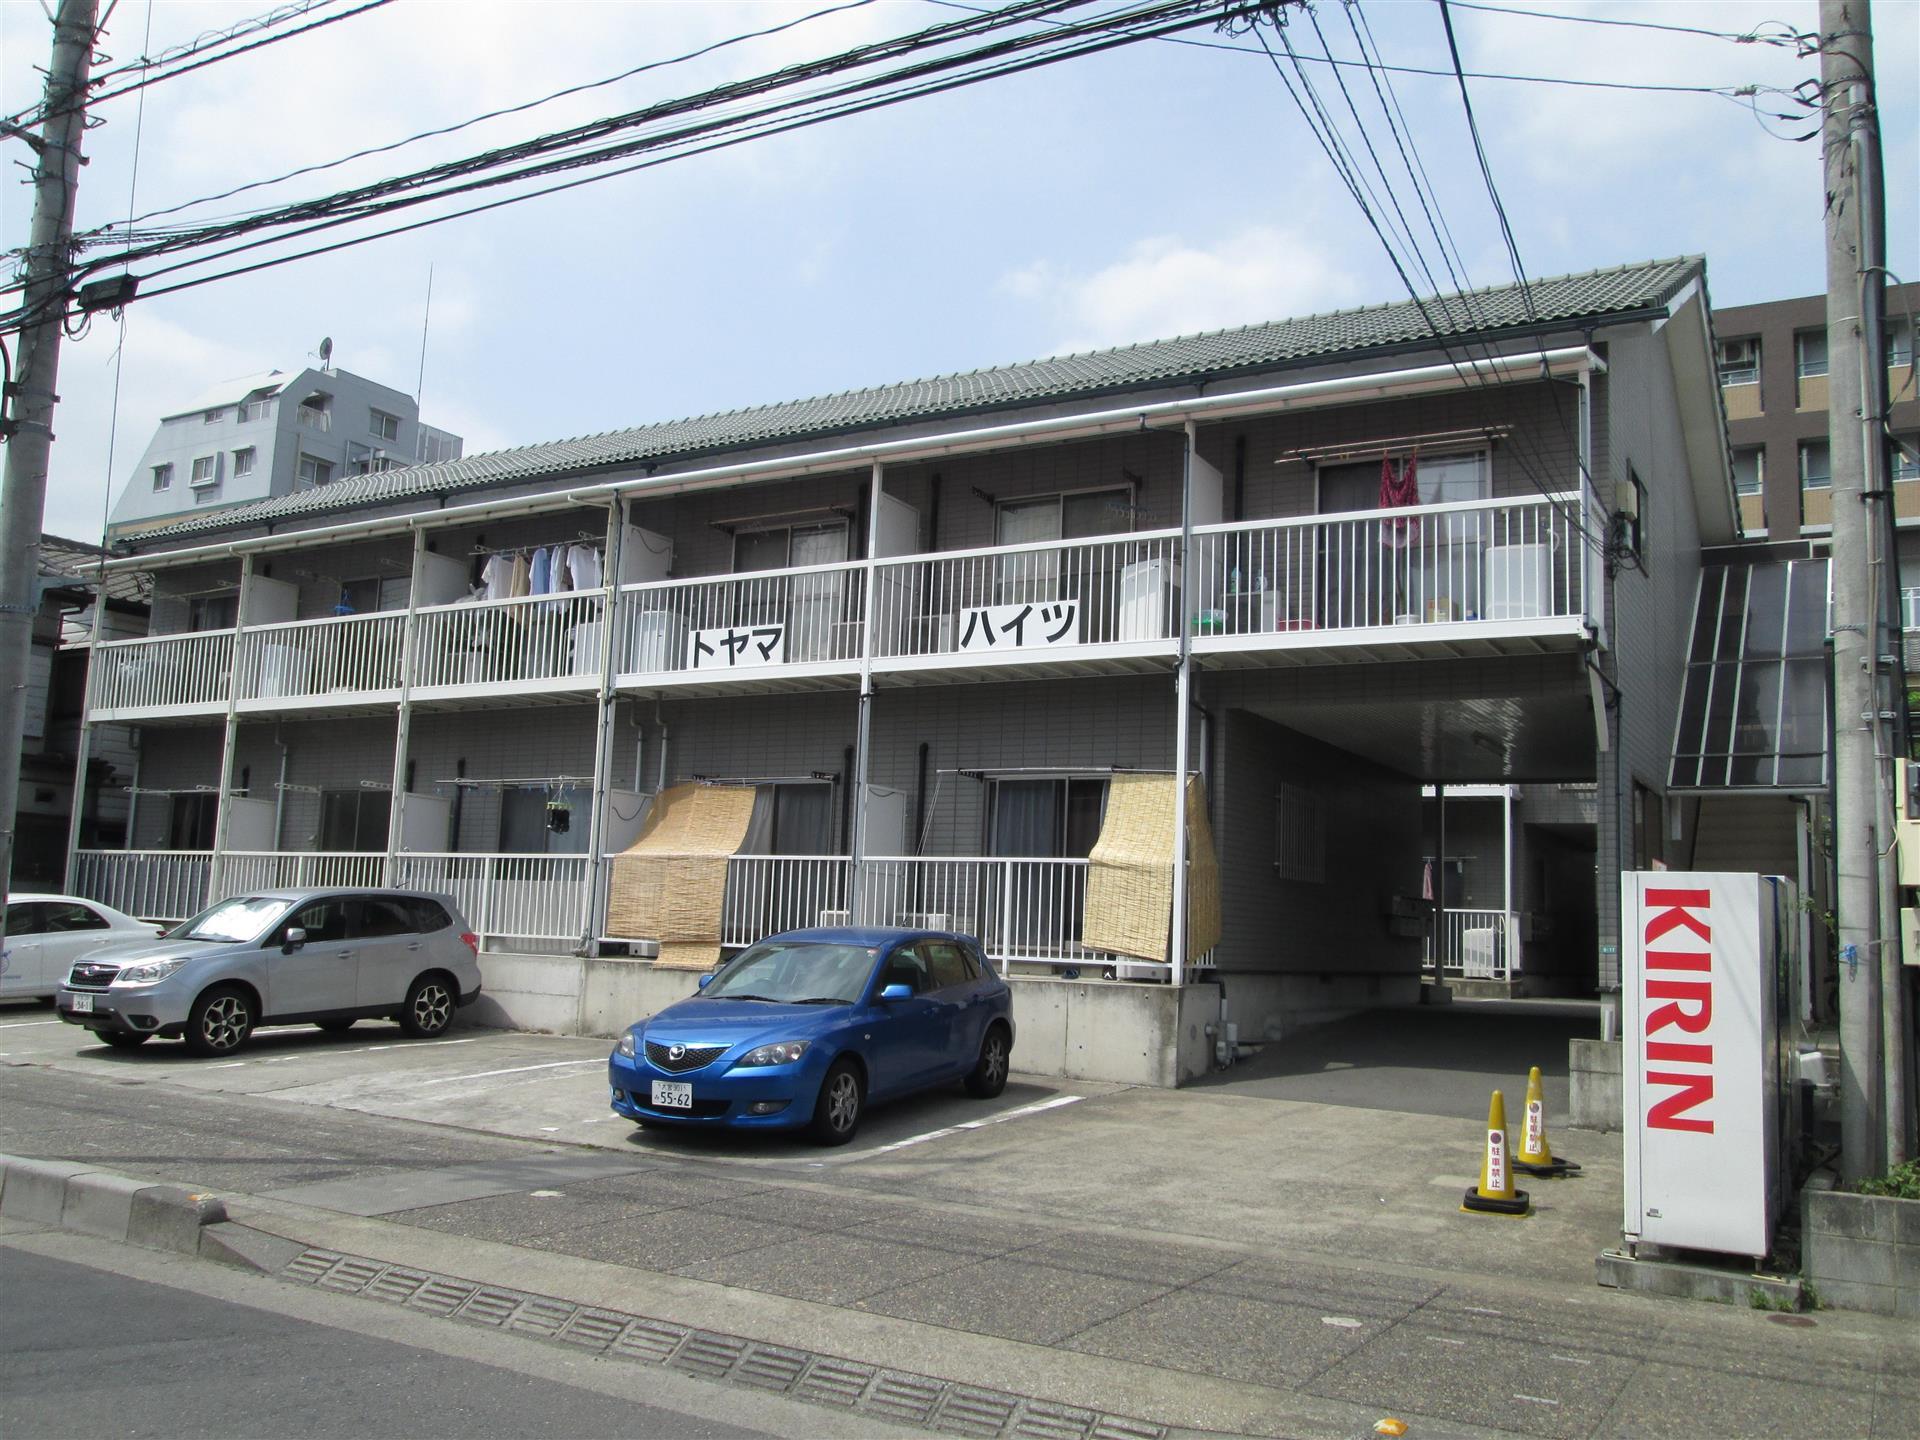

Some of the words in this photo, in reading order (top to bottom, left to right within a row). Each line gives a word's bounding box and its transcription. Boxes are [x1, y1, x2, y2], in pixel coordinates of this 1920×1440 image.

[693, 627, 783, 669] トヤマ
[961, 604, 1076, 649] ハイツ
[1644, 887, 1715, 1135] KIRIN
[660, 1091, 690, 1107] 55-62
[1491, 1147, 1500, 1188] 駐車禁止
